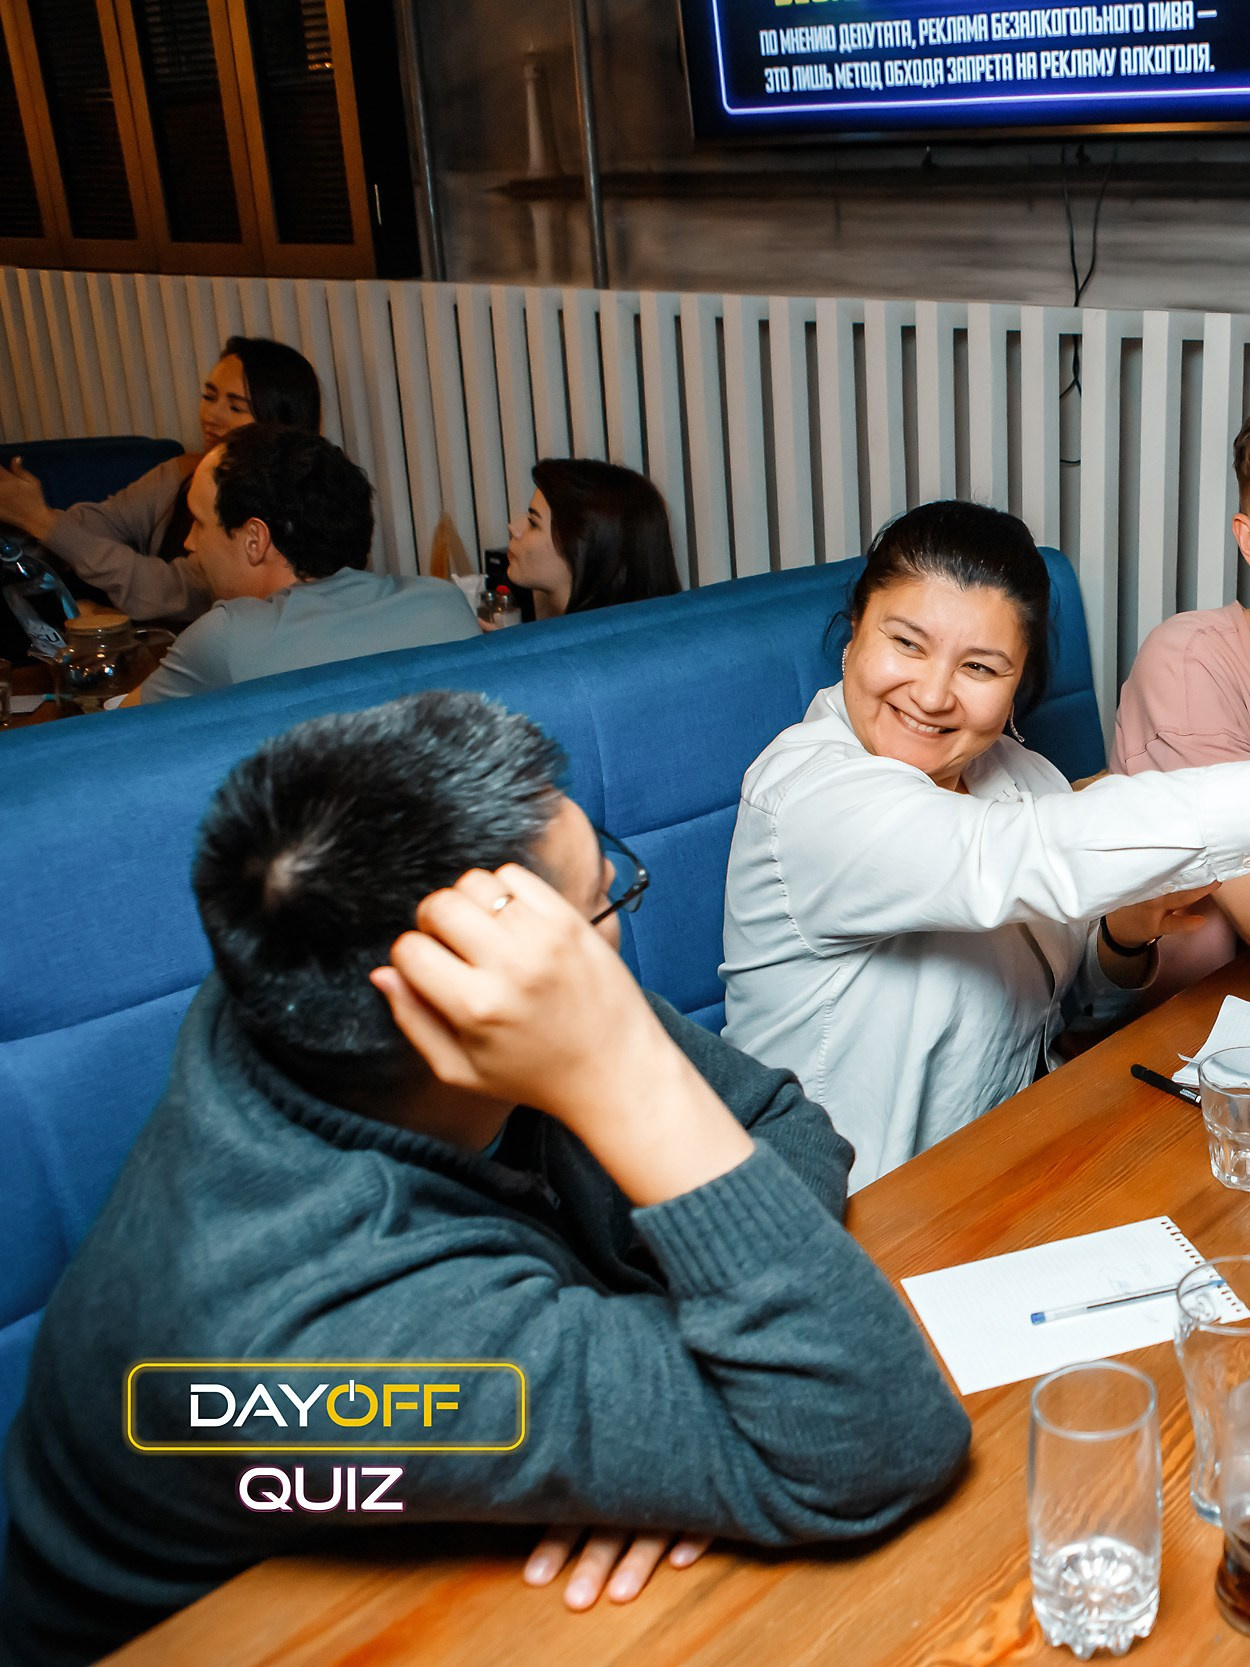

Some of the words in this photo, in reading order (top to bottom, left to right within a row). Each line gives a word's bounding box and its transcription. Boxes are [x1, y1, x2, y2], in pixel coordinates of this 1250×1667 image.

[759, 29, 778, 56] ПО
[779, 24, 837, 55] МНЕНИЮ
[839, 20, 917, 53] ДЕПУТАТА,
[918, 13, 989, 46] РЕКЛАМА
[991, 5, 1145, 41] БЕЗАЛКОГОЛЬНОГО
[1148, 1, 1195, 32] ПИВА
[764, 66, 790, 93] ЭТО
[792, 63, 833, 91] ЛИШЬ
[834, 61, 883, 91] МЕТОД
[884, 57, 945, 88] ОБХОДА
[946, 53, 1013, 84] ЗАПРЕТА
[1016, 51, 1038, 80] НА
[1040, 47, 1116, 79] РЕКЛАМУ
[1120, 42, 1215, 76] АЛКОГОЛЯ.
